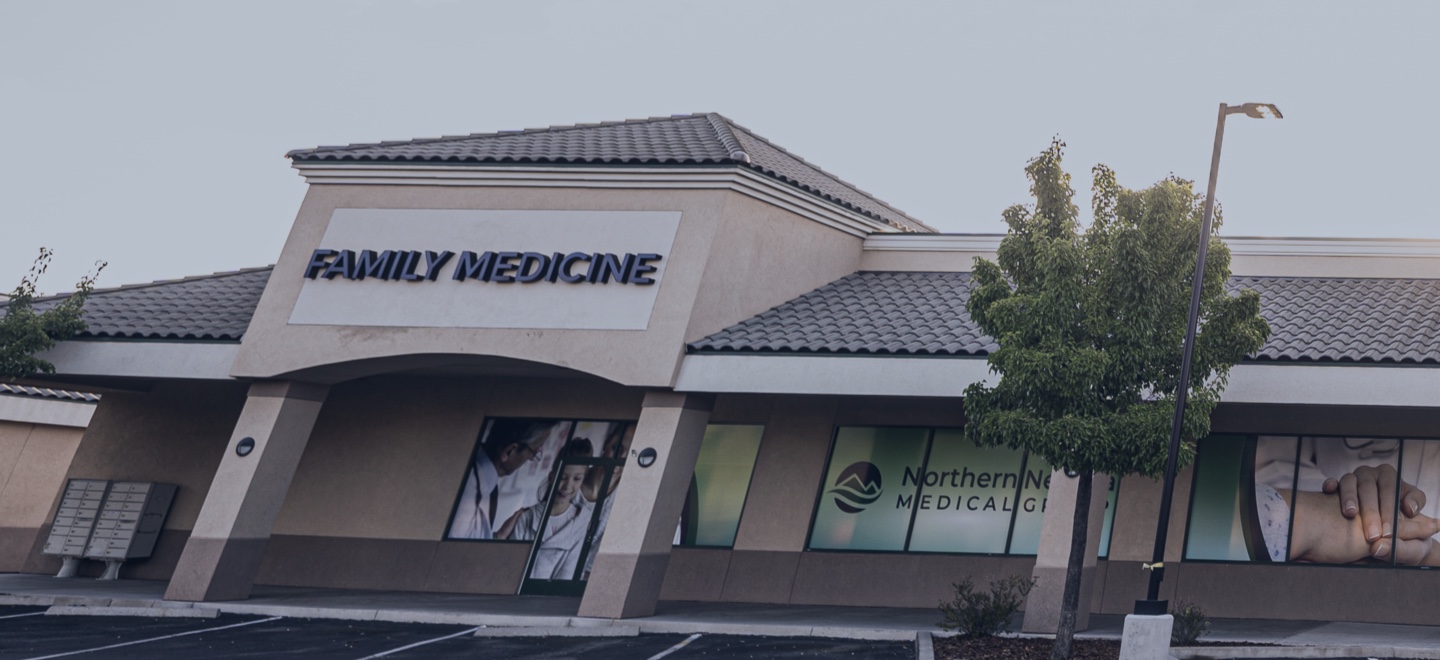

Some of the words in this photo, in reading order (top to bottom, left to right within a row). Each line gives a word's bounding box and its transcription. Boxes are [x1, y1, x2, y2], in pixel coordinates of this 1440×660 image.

[304, 249, 455, 281] FAMILY
[452, 251, 662, 285] MEDICINE
[902, 466, 1017, 489] Northern
[896, 494, 1013, 512] MEDICAL
